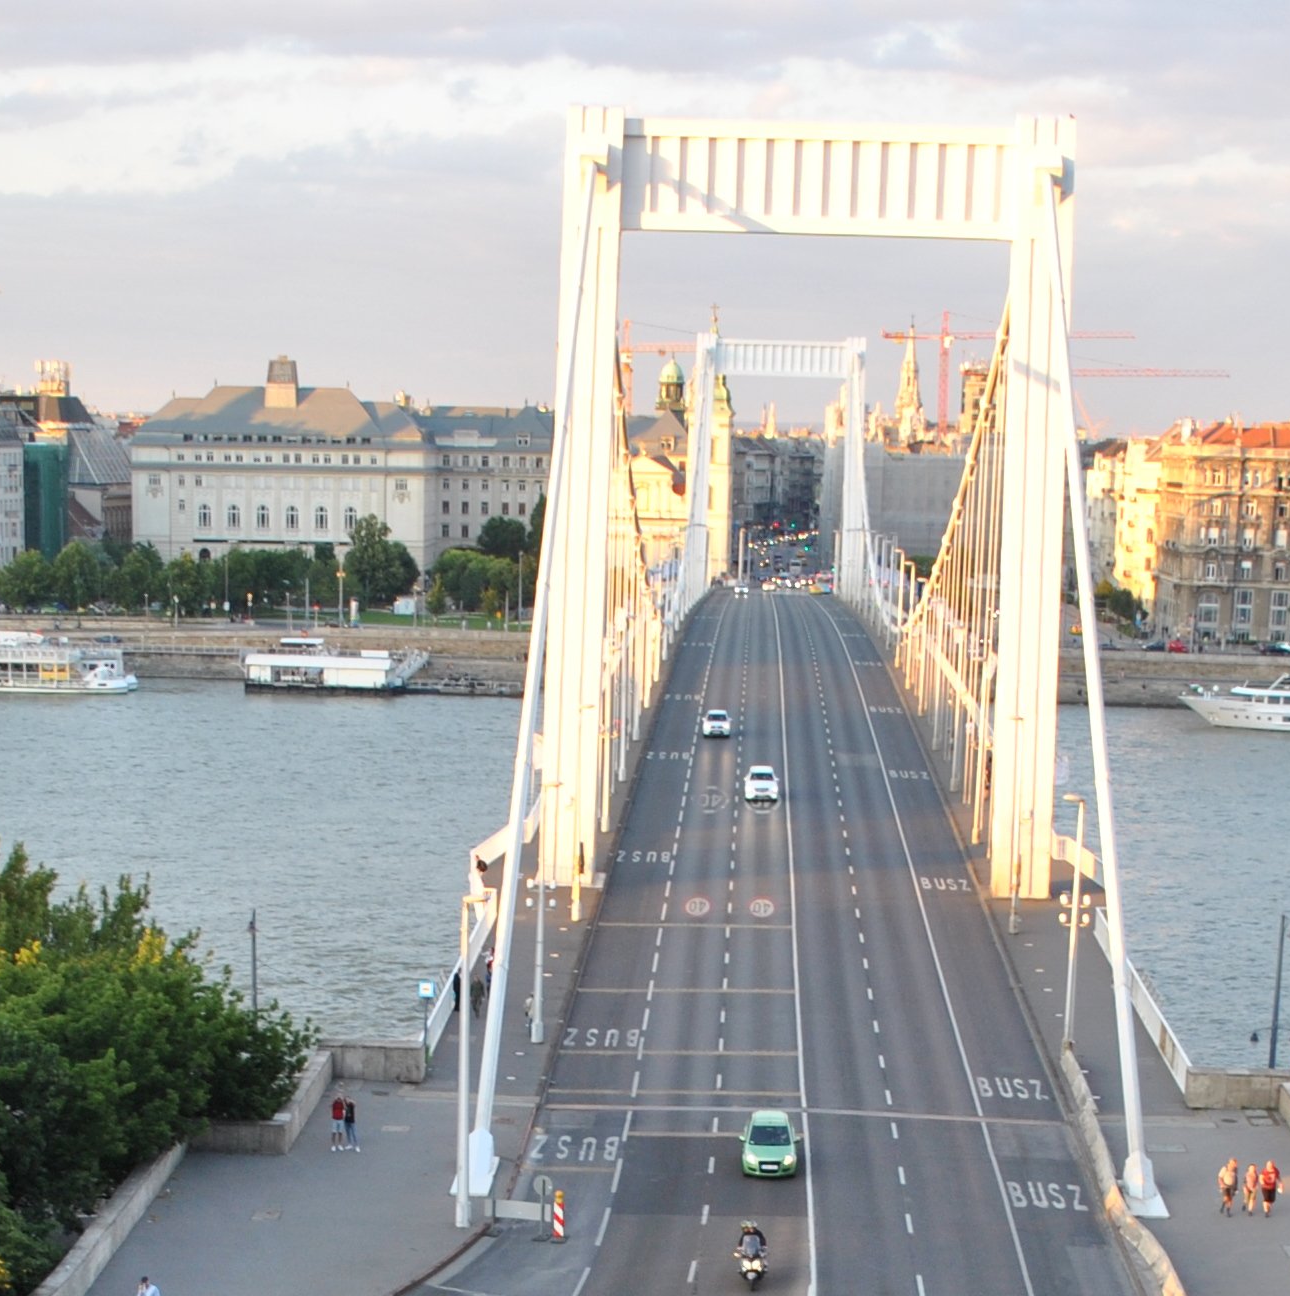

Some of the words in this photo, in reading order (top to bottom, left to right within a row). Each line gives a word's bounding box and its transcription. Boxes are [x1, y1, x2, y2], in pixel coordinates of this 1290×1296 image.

[888, 769, 930, 780] BUSZ
[616, 850, 672, 863] BUSZ
[920, 876, 972, 892] BUSZ
[563, 1028, 640, 1047] BUSZ
[976, 1077, 1049, 1100] BUSZ
[530, 1134, 620, 1161] BUSZ
[1007, 1181, 1089, 1212] BUSZ
